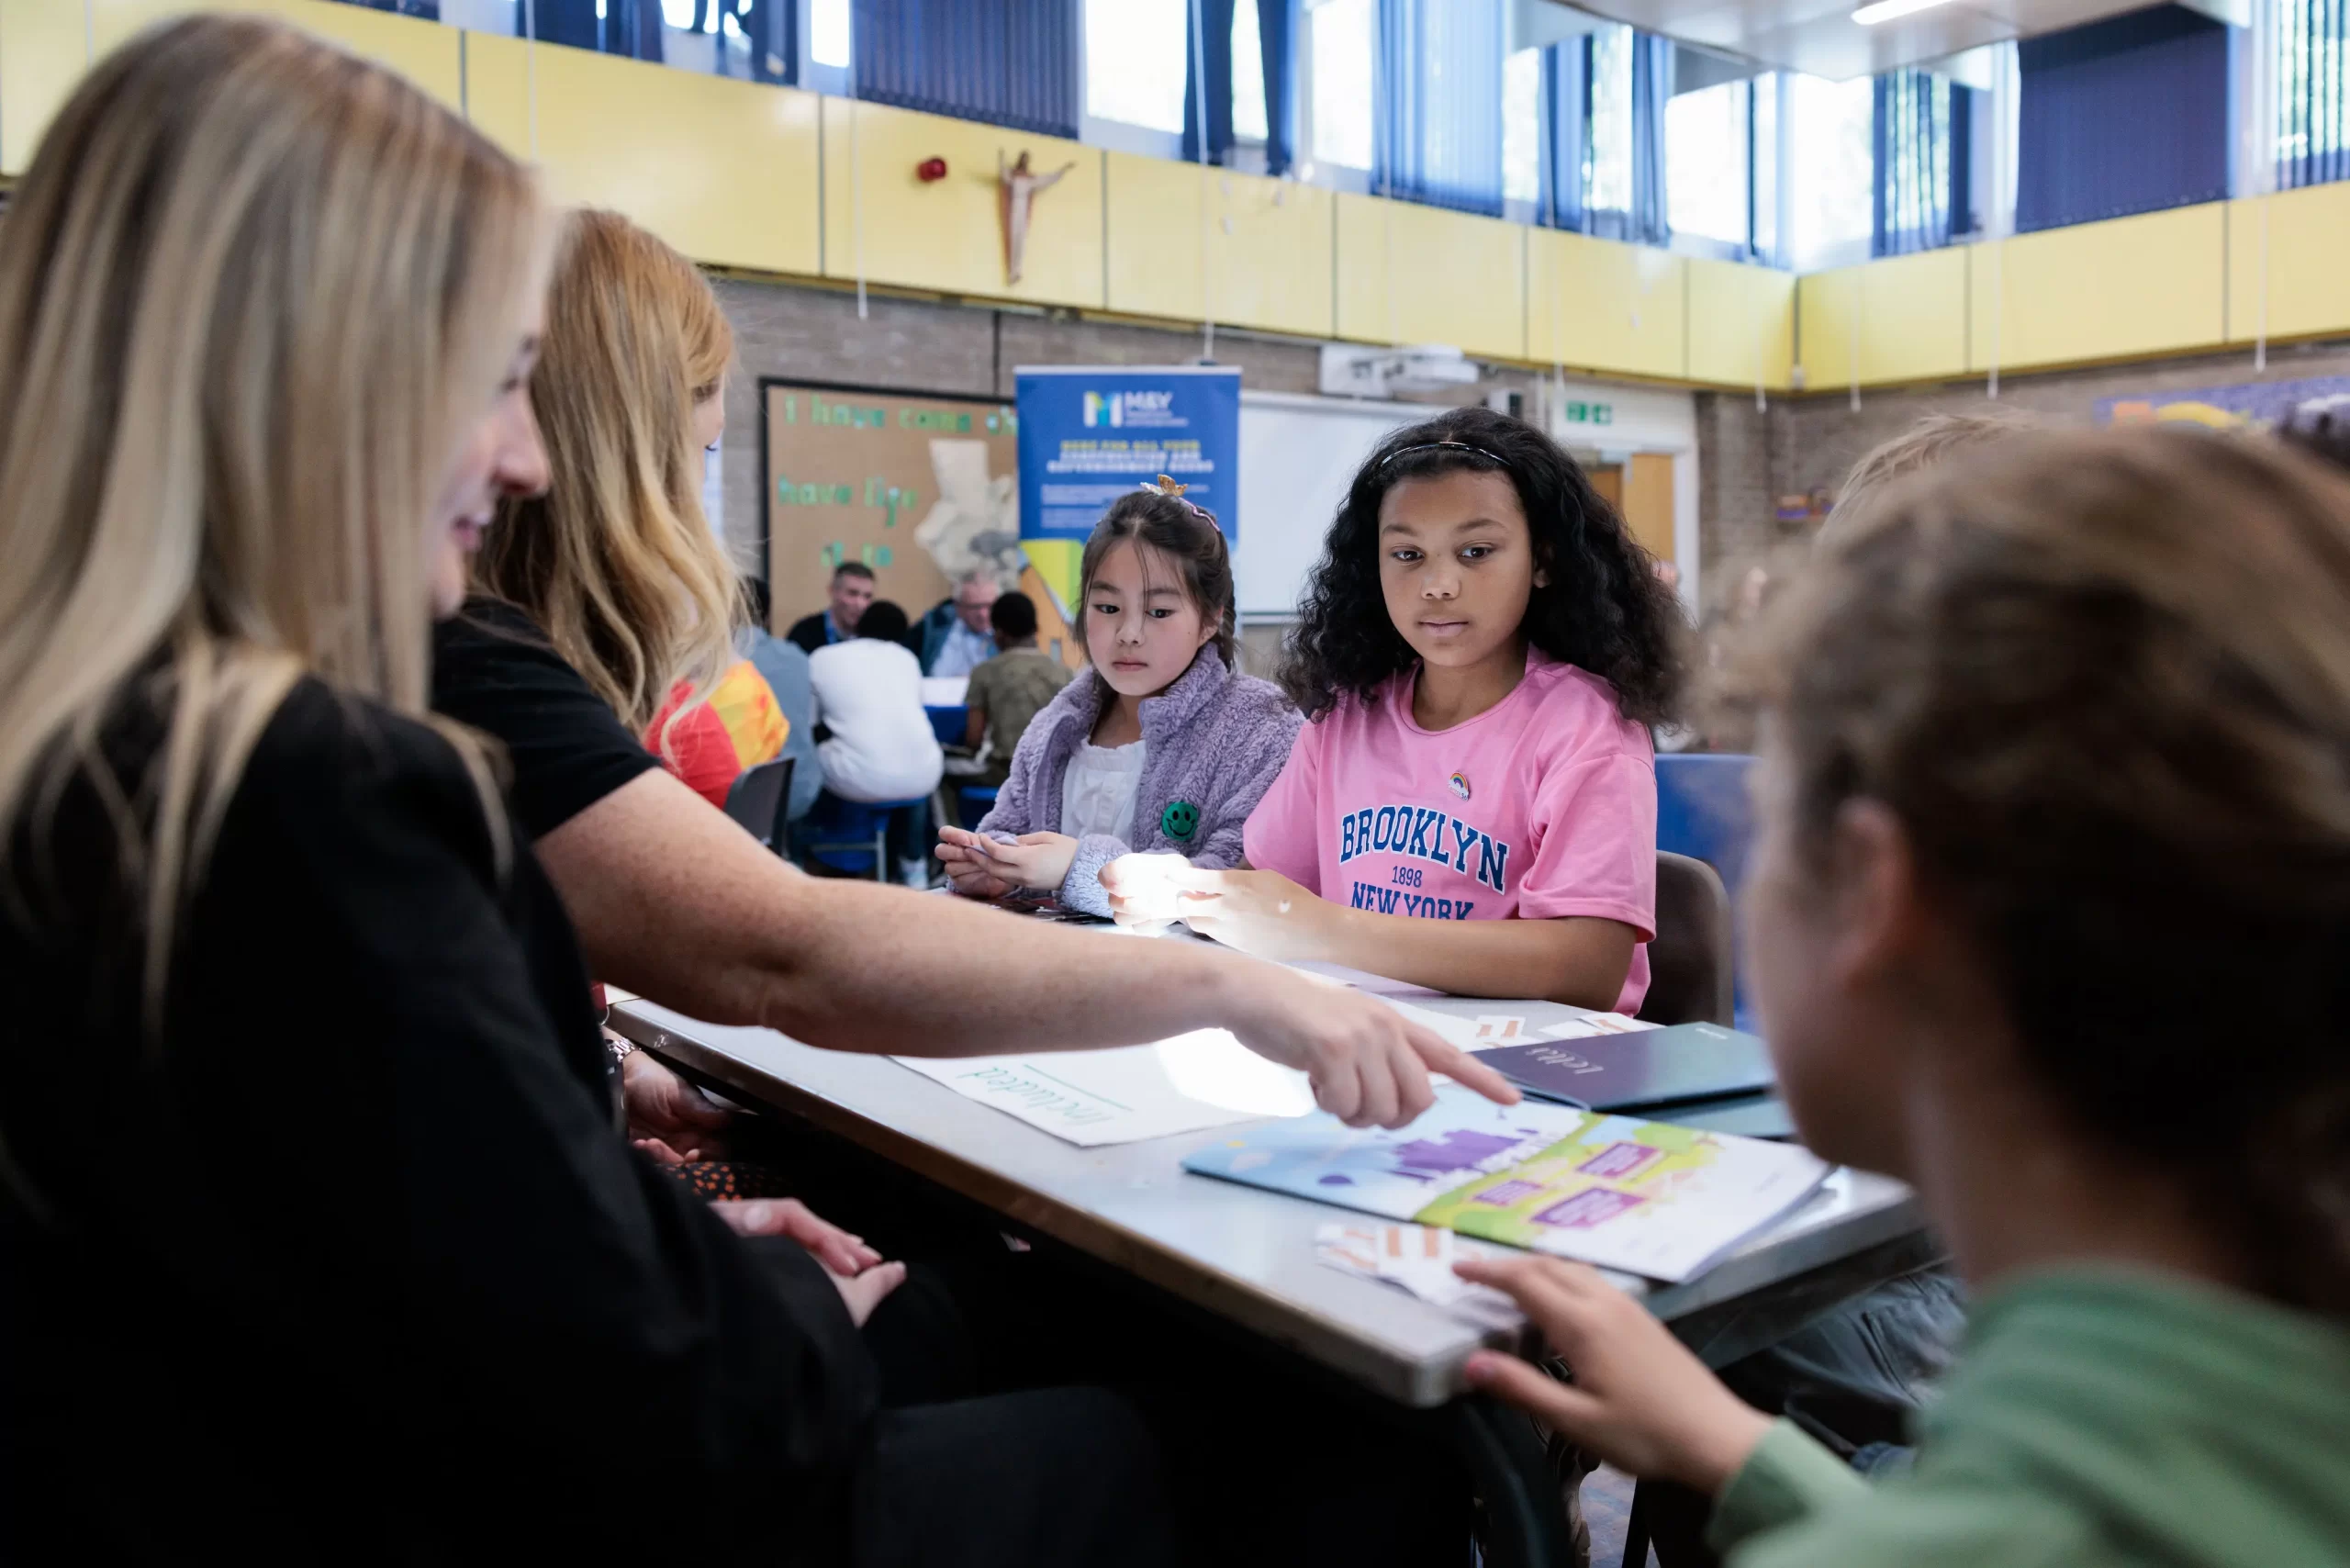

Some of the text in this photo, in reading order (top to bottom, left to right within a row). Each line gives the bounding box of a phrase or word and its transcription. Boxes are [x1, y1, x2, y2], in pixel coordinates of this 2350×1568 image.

[1339, 804, 1510, 896] BROOKLYN
[1392, 866, 1423, 888] 1898
[1350, 881, 1474, 921] NEW YORK
